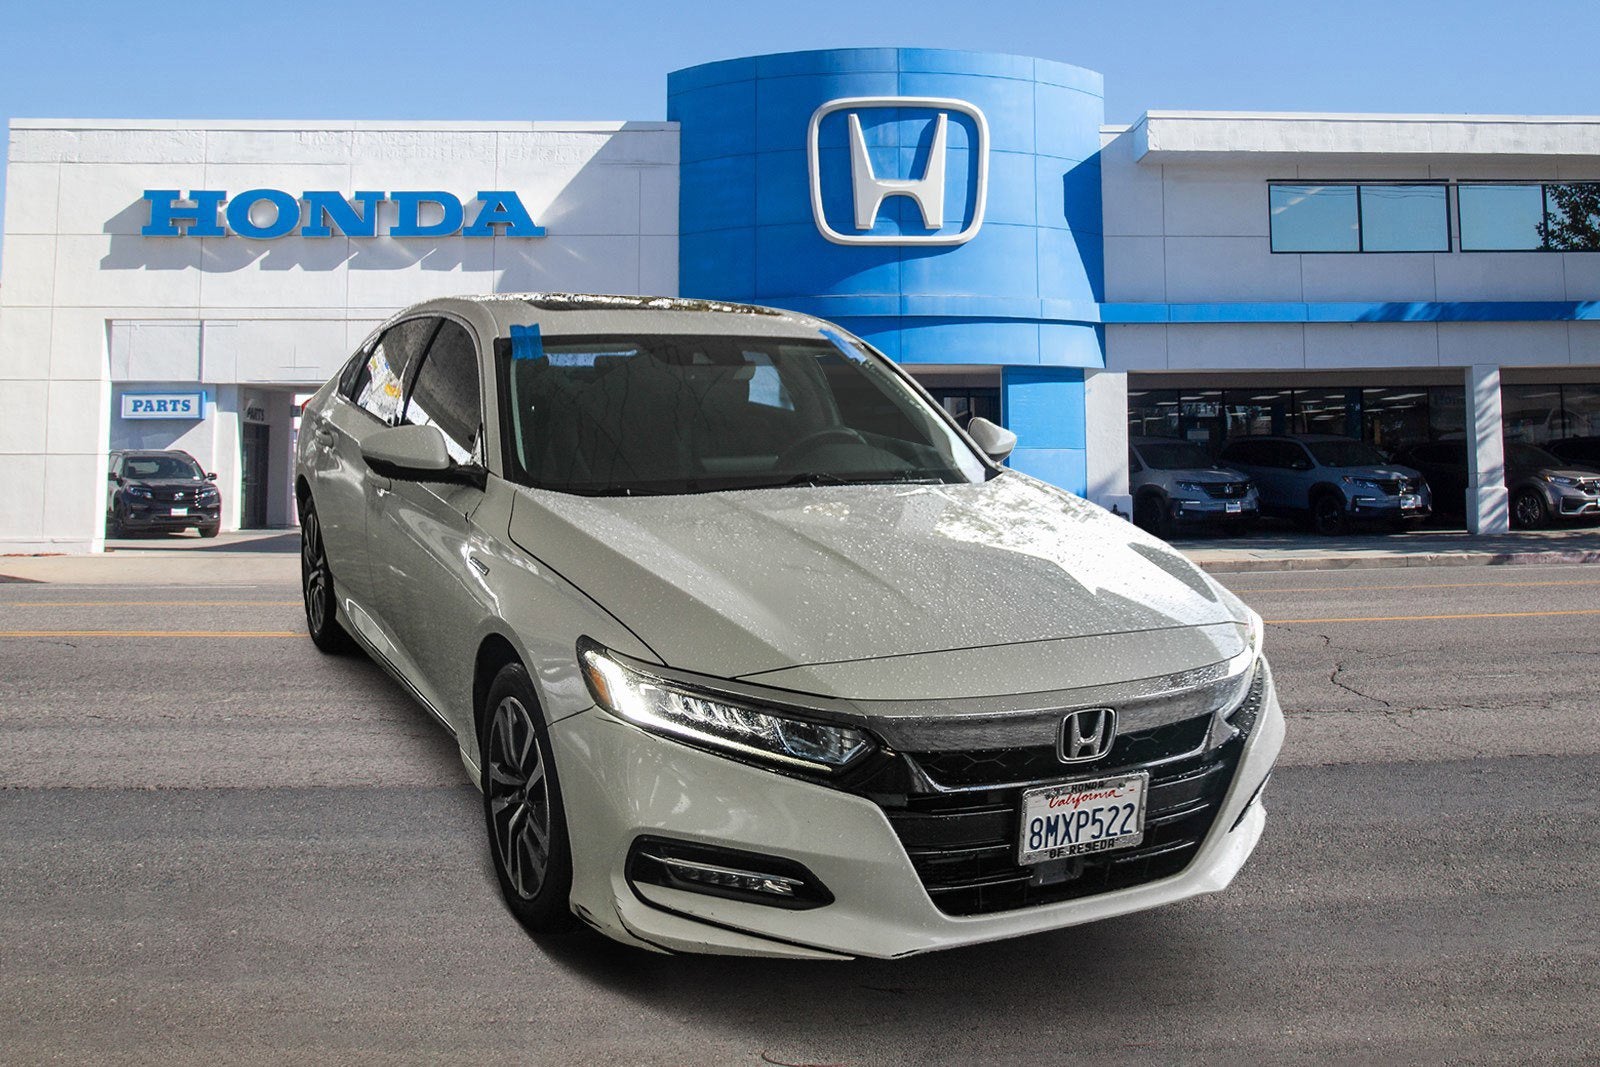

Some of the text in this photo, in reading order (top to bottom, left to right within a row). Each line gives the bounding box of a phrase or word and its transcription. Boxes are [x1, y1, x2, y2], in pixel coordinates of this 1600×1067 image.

[142, 189, 547, 239] HONDA
[132, 399, 191, 412] PARTS
[1070, 780, 1105, 794] HONDA
[1049, 788, 1123, 809] California
[1029, 802, 1136, 850] 8MXP522
[1049, 839, 1115, 859] OF RESEDA
